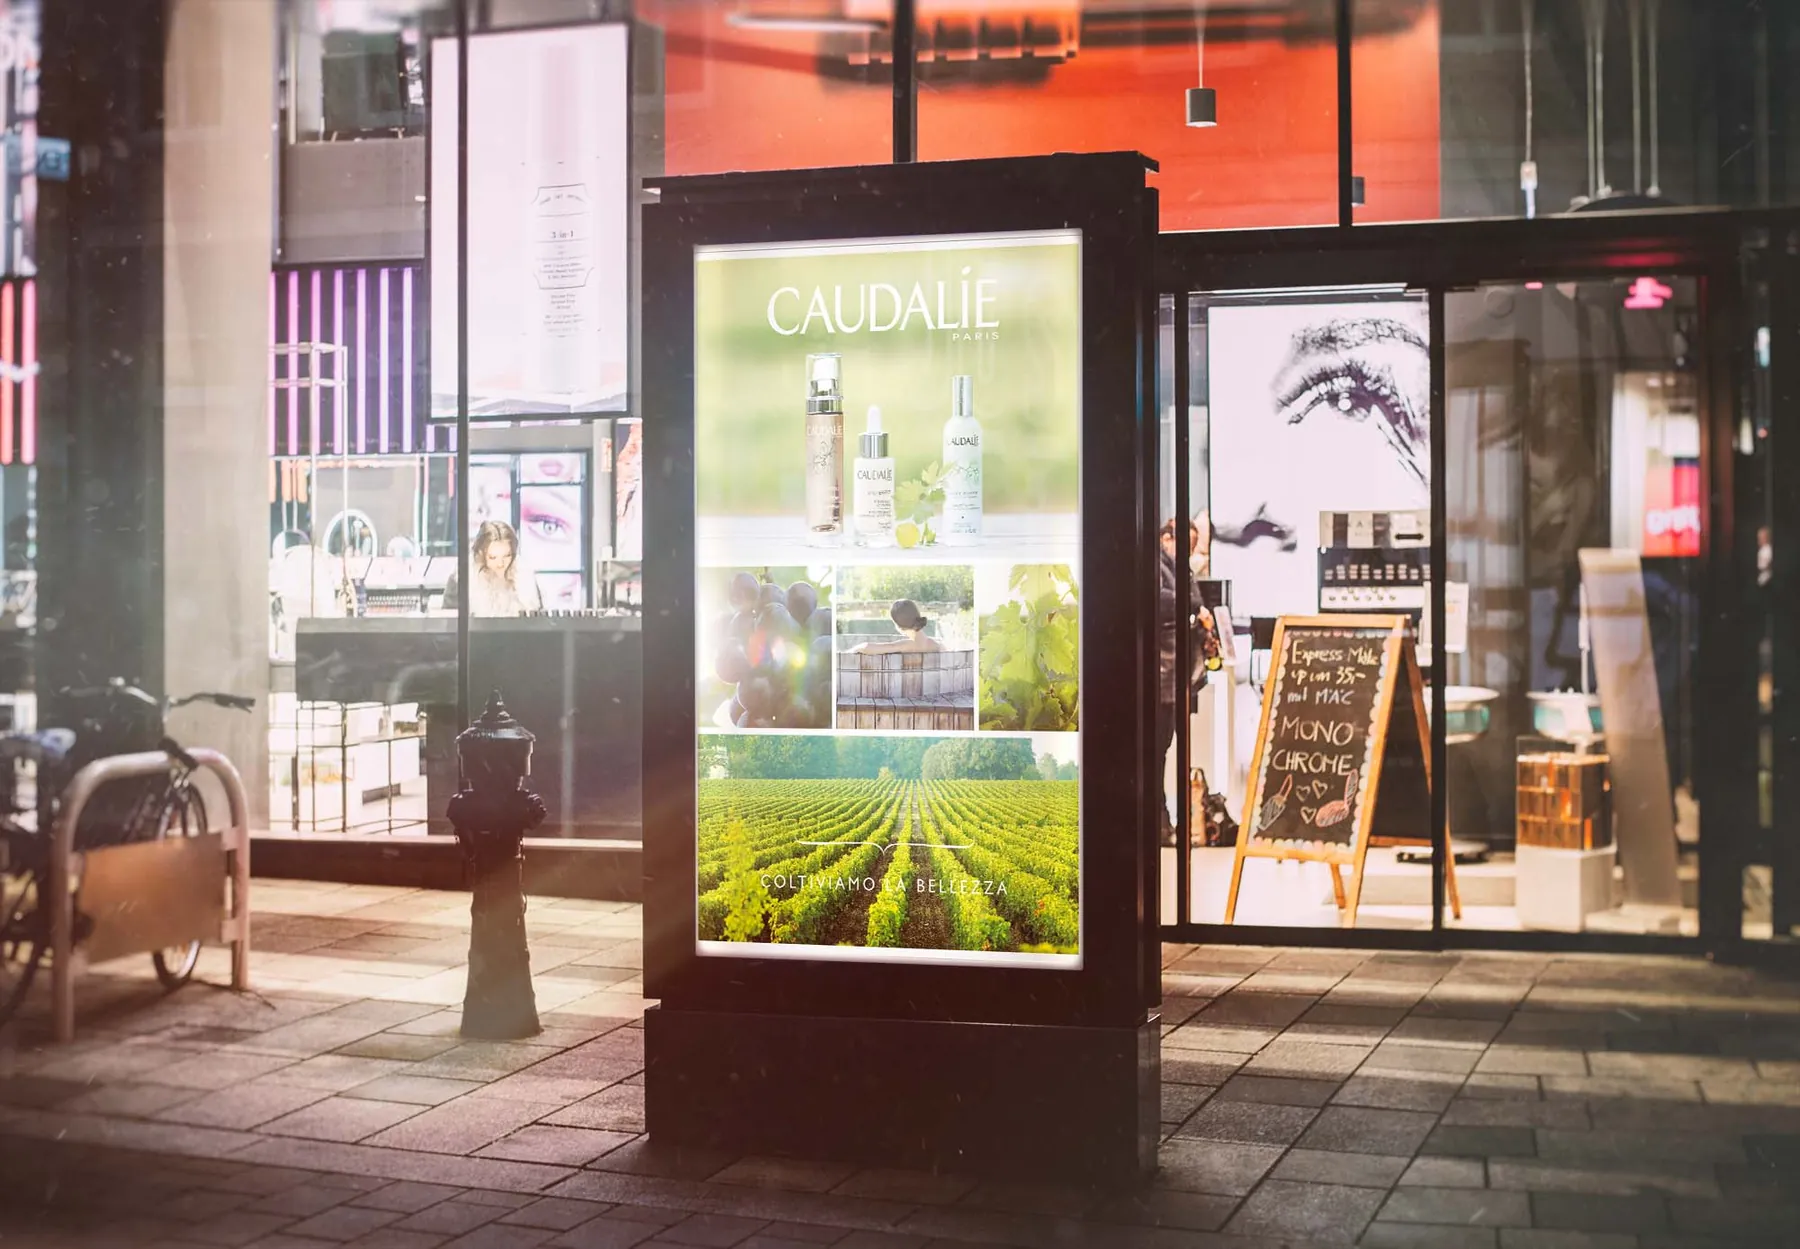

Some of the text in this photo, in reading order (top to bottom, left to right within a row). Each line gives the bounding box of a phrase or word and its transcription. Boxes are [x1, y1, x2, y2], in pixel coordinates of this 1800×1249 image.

[952, 332, 999, 341] PARIS
[1292, 639, 1343, 666] Express
[1280, 716, 1353, 746] MONO
[1273, 749, 1353, 776] CHROME
[760, 874, 1007, 895] COLTIVIAMO LA BELLEZZA
